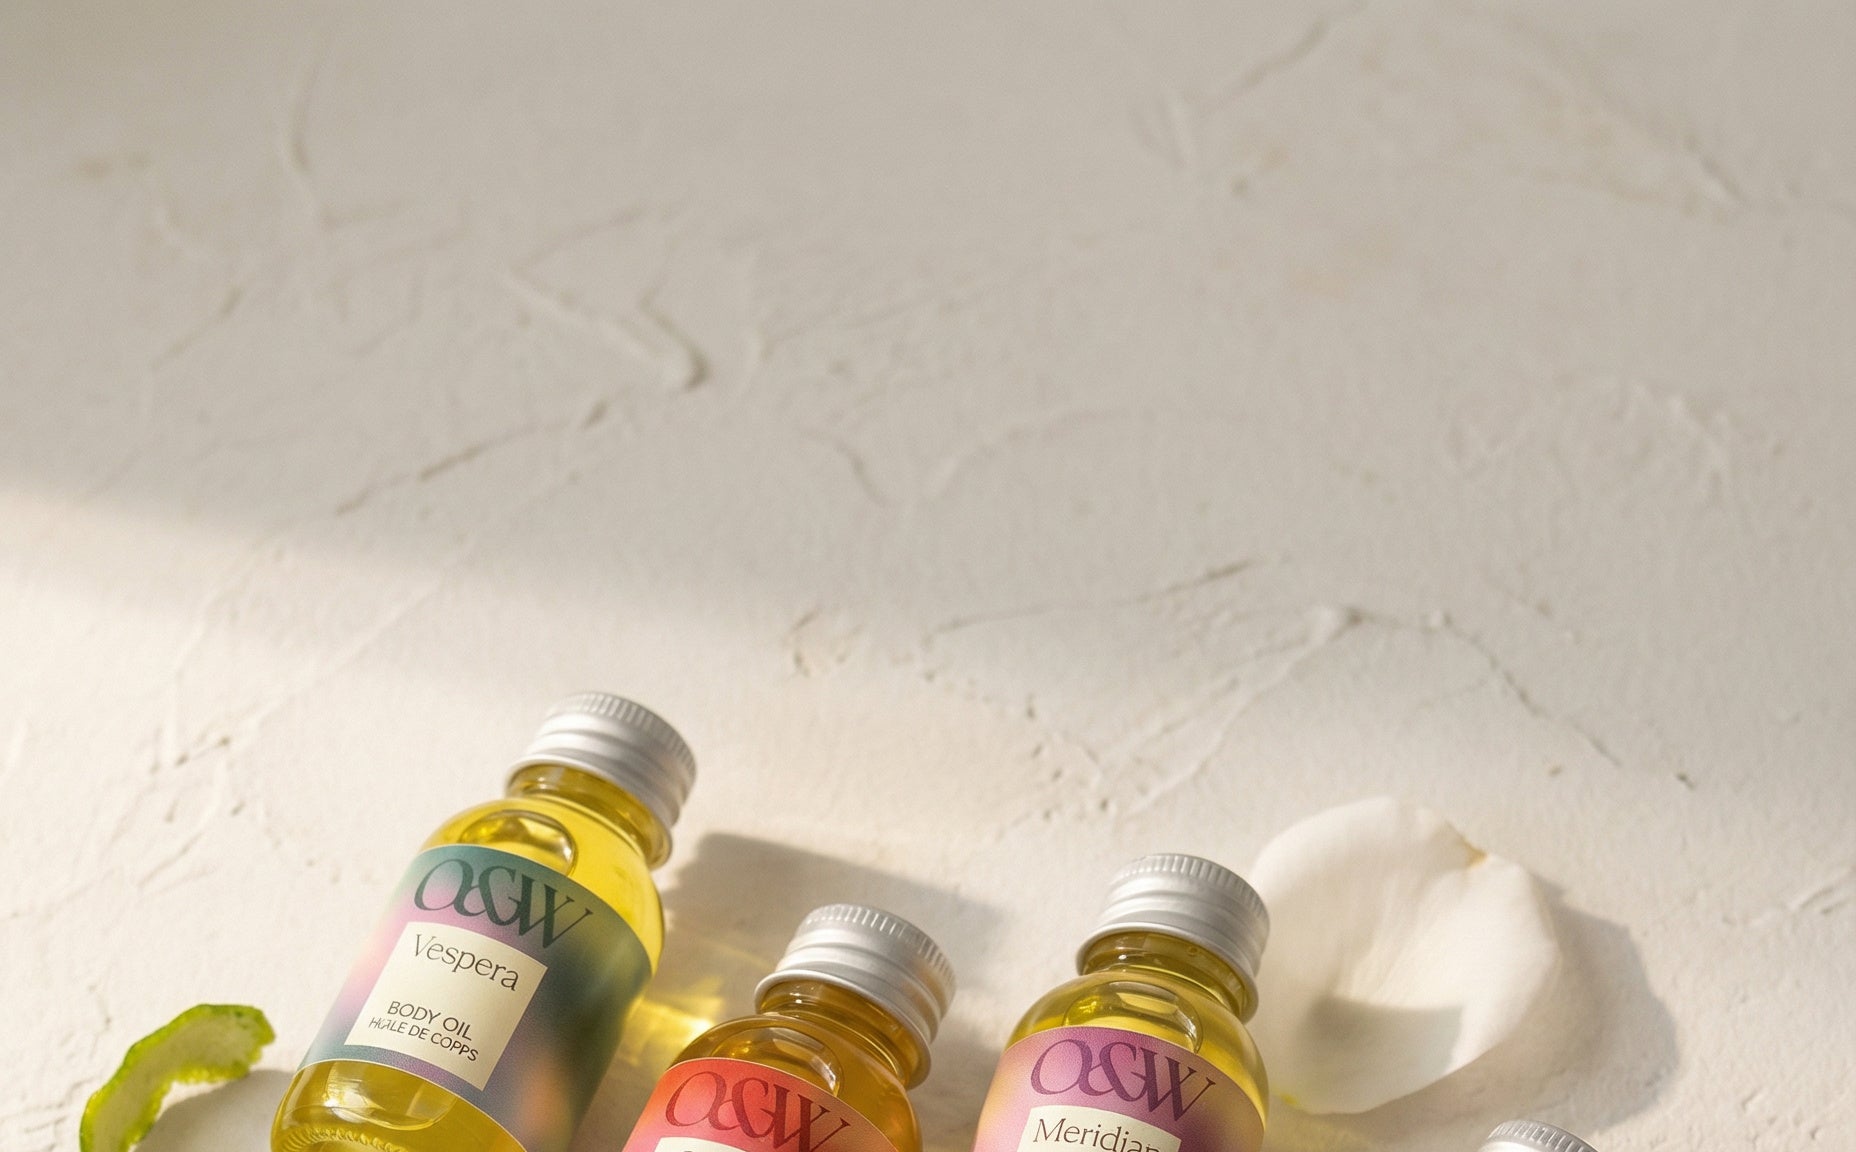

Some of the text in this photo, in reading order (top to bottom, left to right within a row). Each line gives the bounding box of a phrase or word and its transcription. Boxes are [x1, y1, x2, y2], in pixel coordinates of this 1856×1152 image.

[415, 933, 520, 992] Vespera
[387, 1001, 472, 1041] BODY OIL
[408, 1025, 430, 1040] DE
